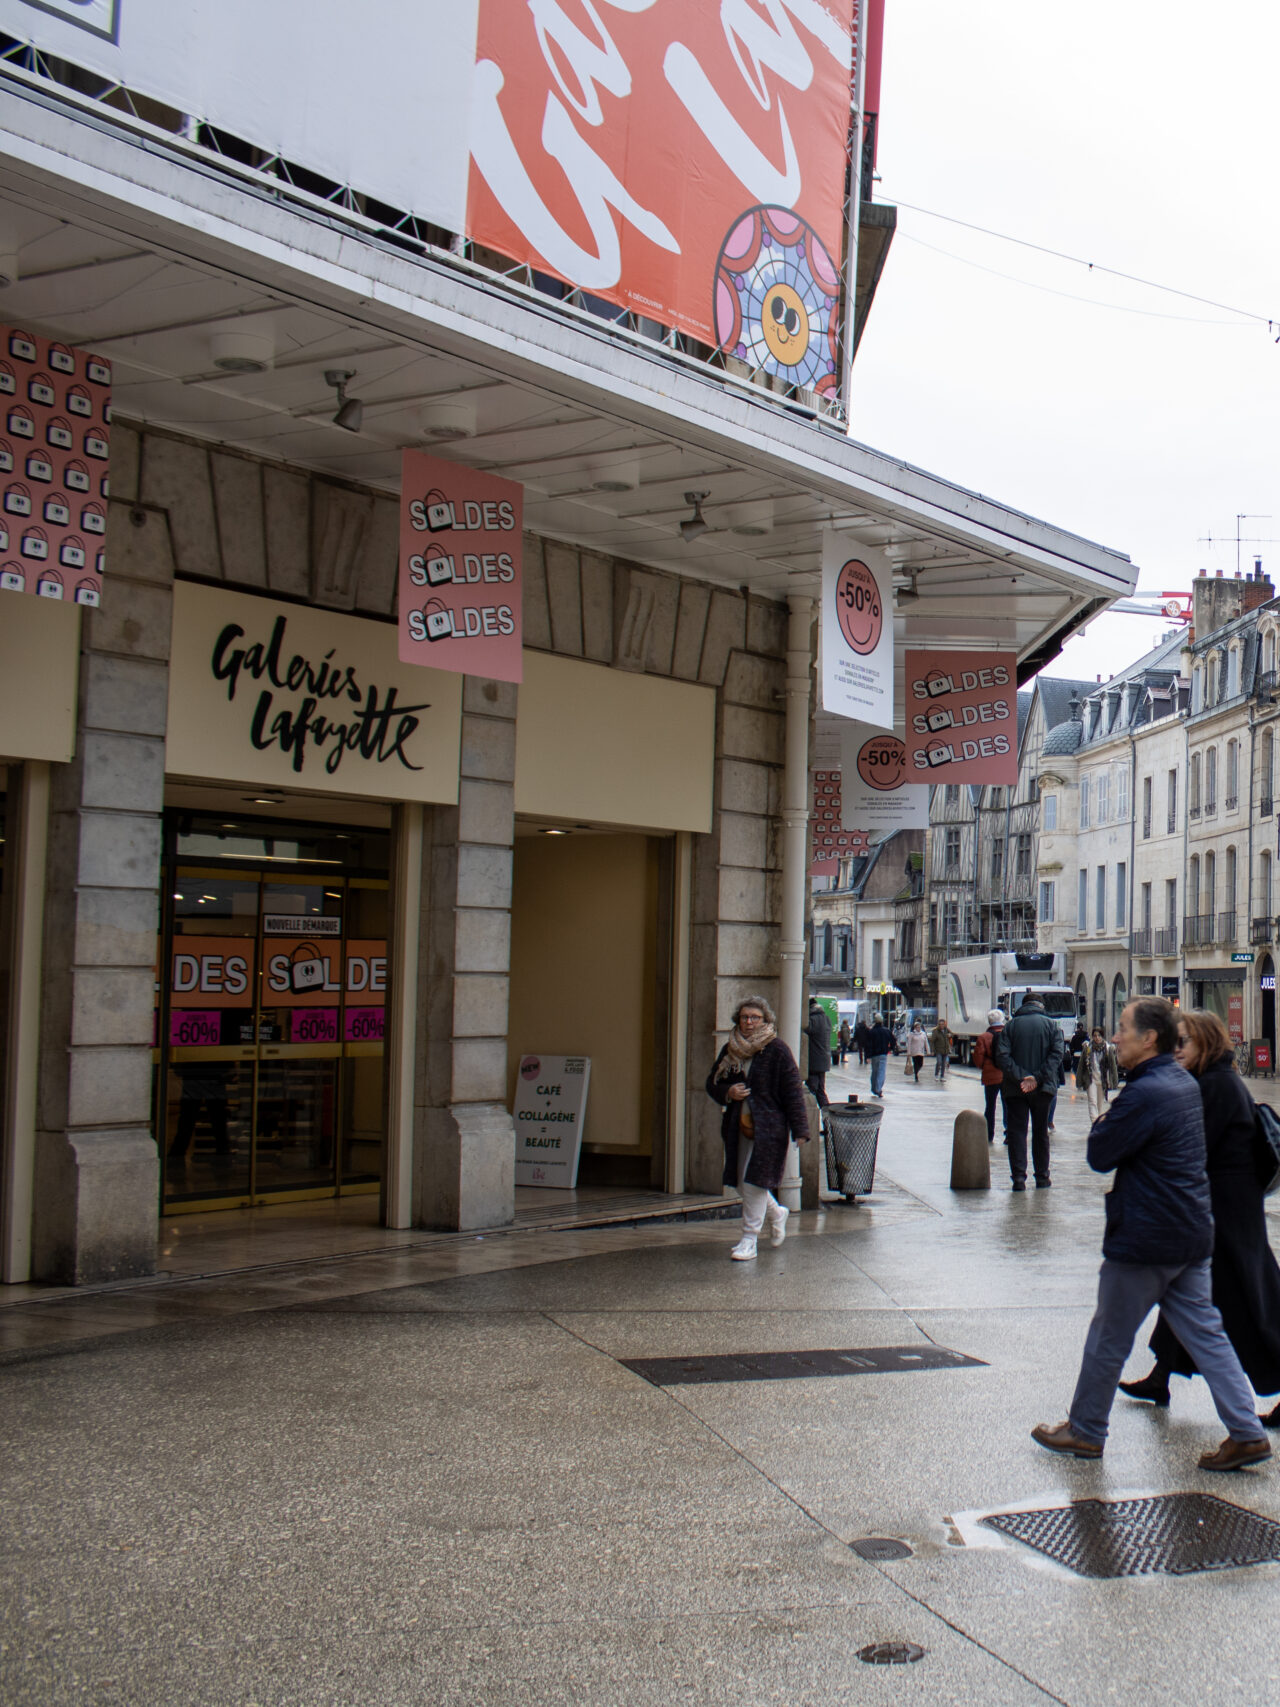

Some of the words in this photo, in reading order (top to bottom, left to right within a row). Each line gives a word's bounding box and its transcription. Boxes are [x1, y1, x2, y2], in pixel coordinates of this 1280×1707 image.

[409, 498, 516, 532] SOLDES
[409, 552, 516, 587] SOLDES
[839, 581, 880, 618] -50%
[408, 605, 516, 642] SOLDES
[211, 615, 362, 701] Galeries
[912, 665, 1009, 699] SOLDES
[251, 684, 432, 774] Lafayette
[912, 699, 1010, 734] SOLDES
[860, 749, 906, 767] -50%
[913, 733, 1010, 769] SOLDES
[266, 918, 302, 931] NOUVELLE
[302, 918, 339, 932] DÉMARQUE
[173, 1022, 218, 1043] -60%
[294, 1019, 336, 1039] -60%
[521, 1062, 540, 1075] NEW
[537, 1083, 562, 1096] CAFÉ
[525, 1136, 562, 1149] BEAUTÉ
